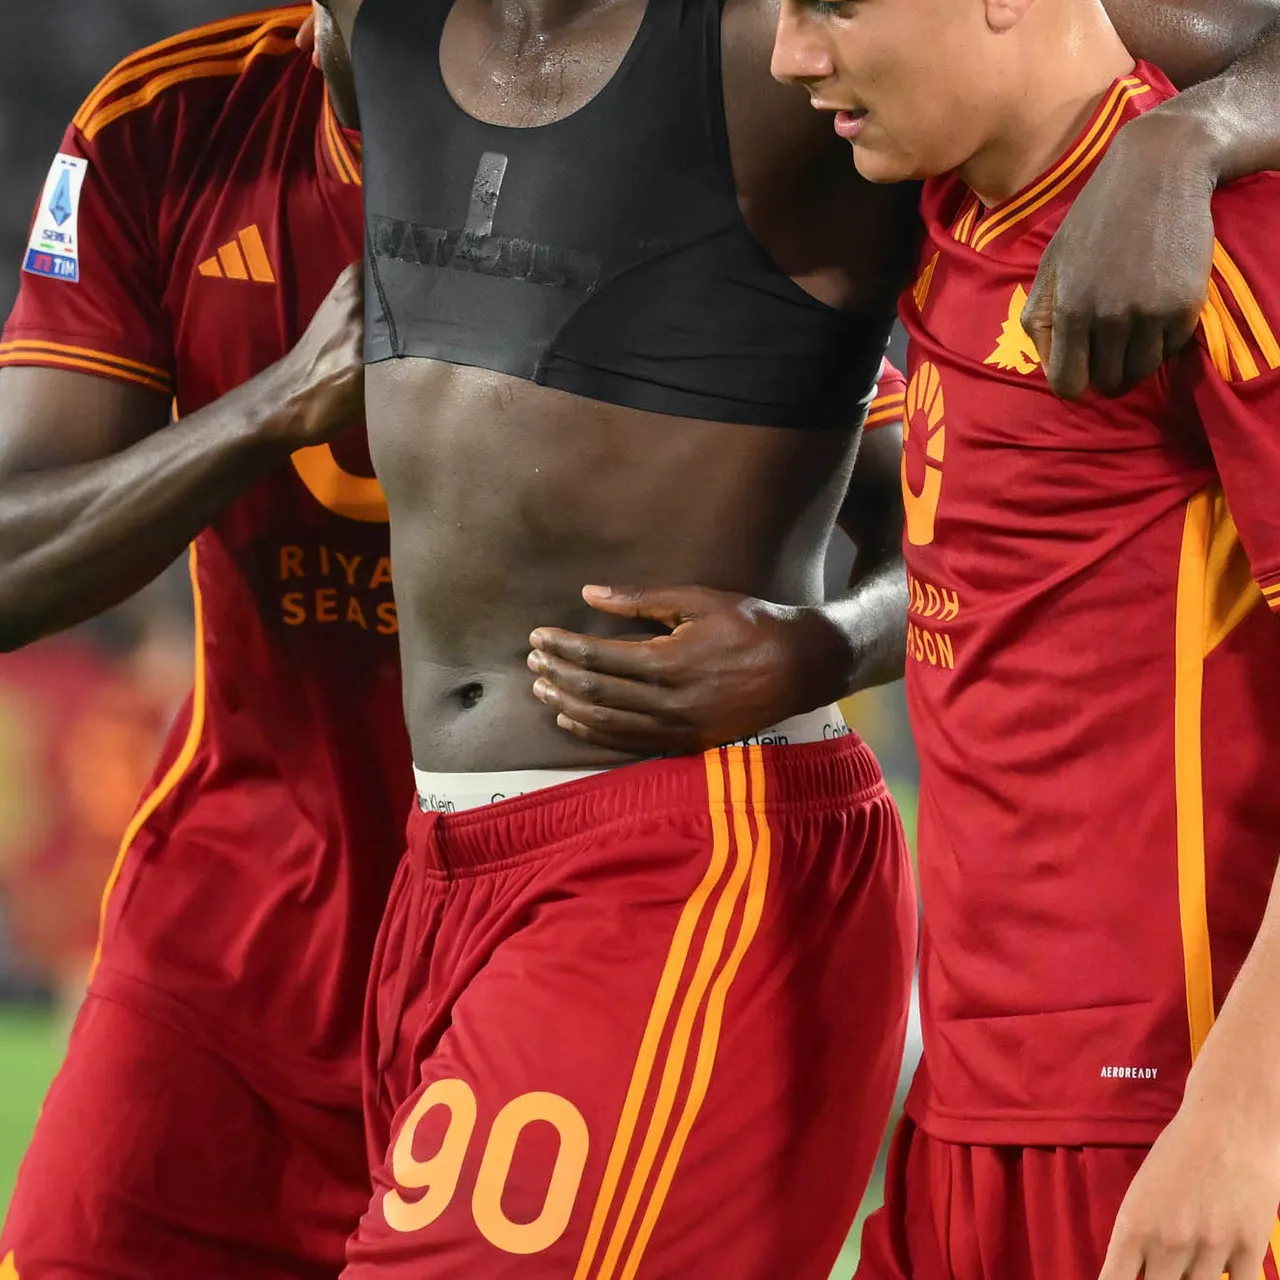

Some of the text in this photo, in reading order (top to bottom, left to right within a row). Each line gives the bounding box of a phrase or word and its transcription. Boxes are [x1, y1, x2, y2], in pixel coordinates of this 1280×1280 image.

[280, 544, 393, 590] RIYA
[281, 587, 401, 635] SEAS
[1100, 1066, 1158, 1079] AEROREADY
[382, 1078, 590, 1255] 90
